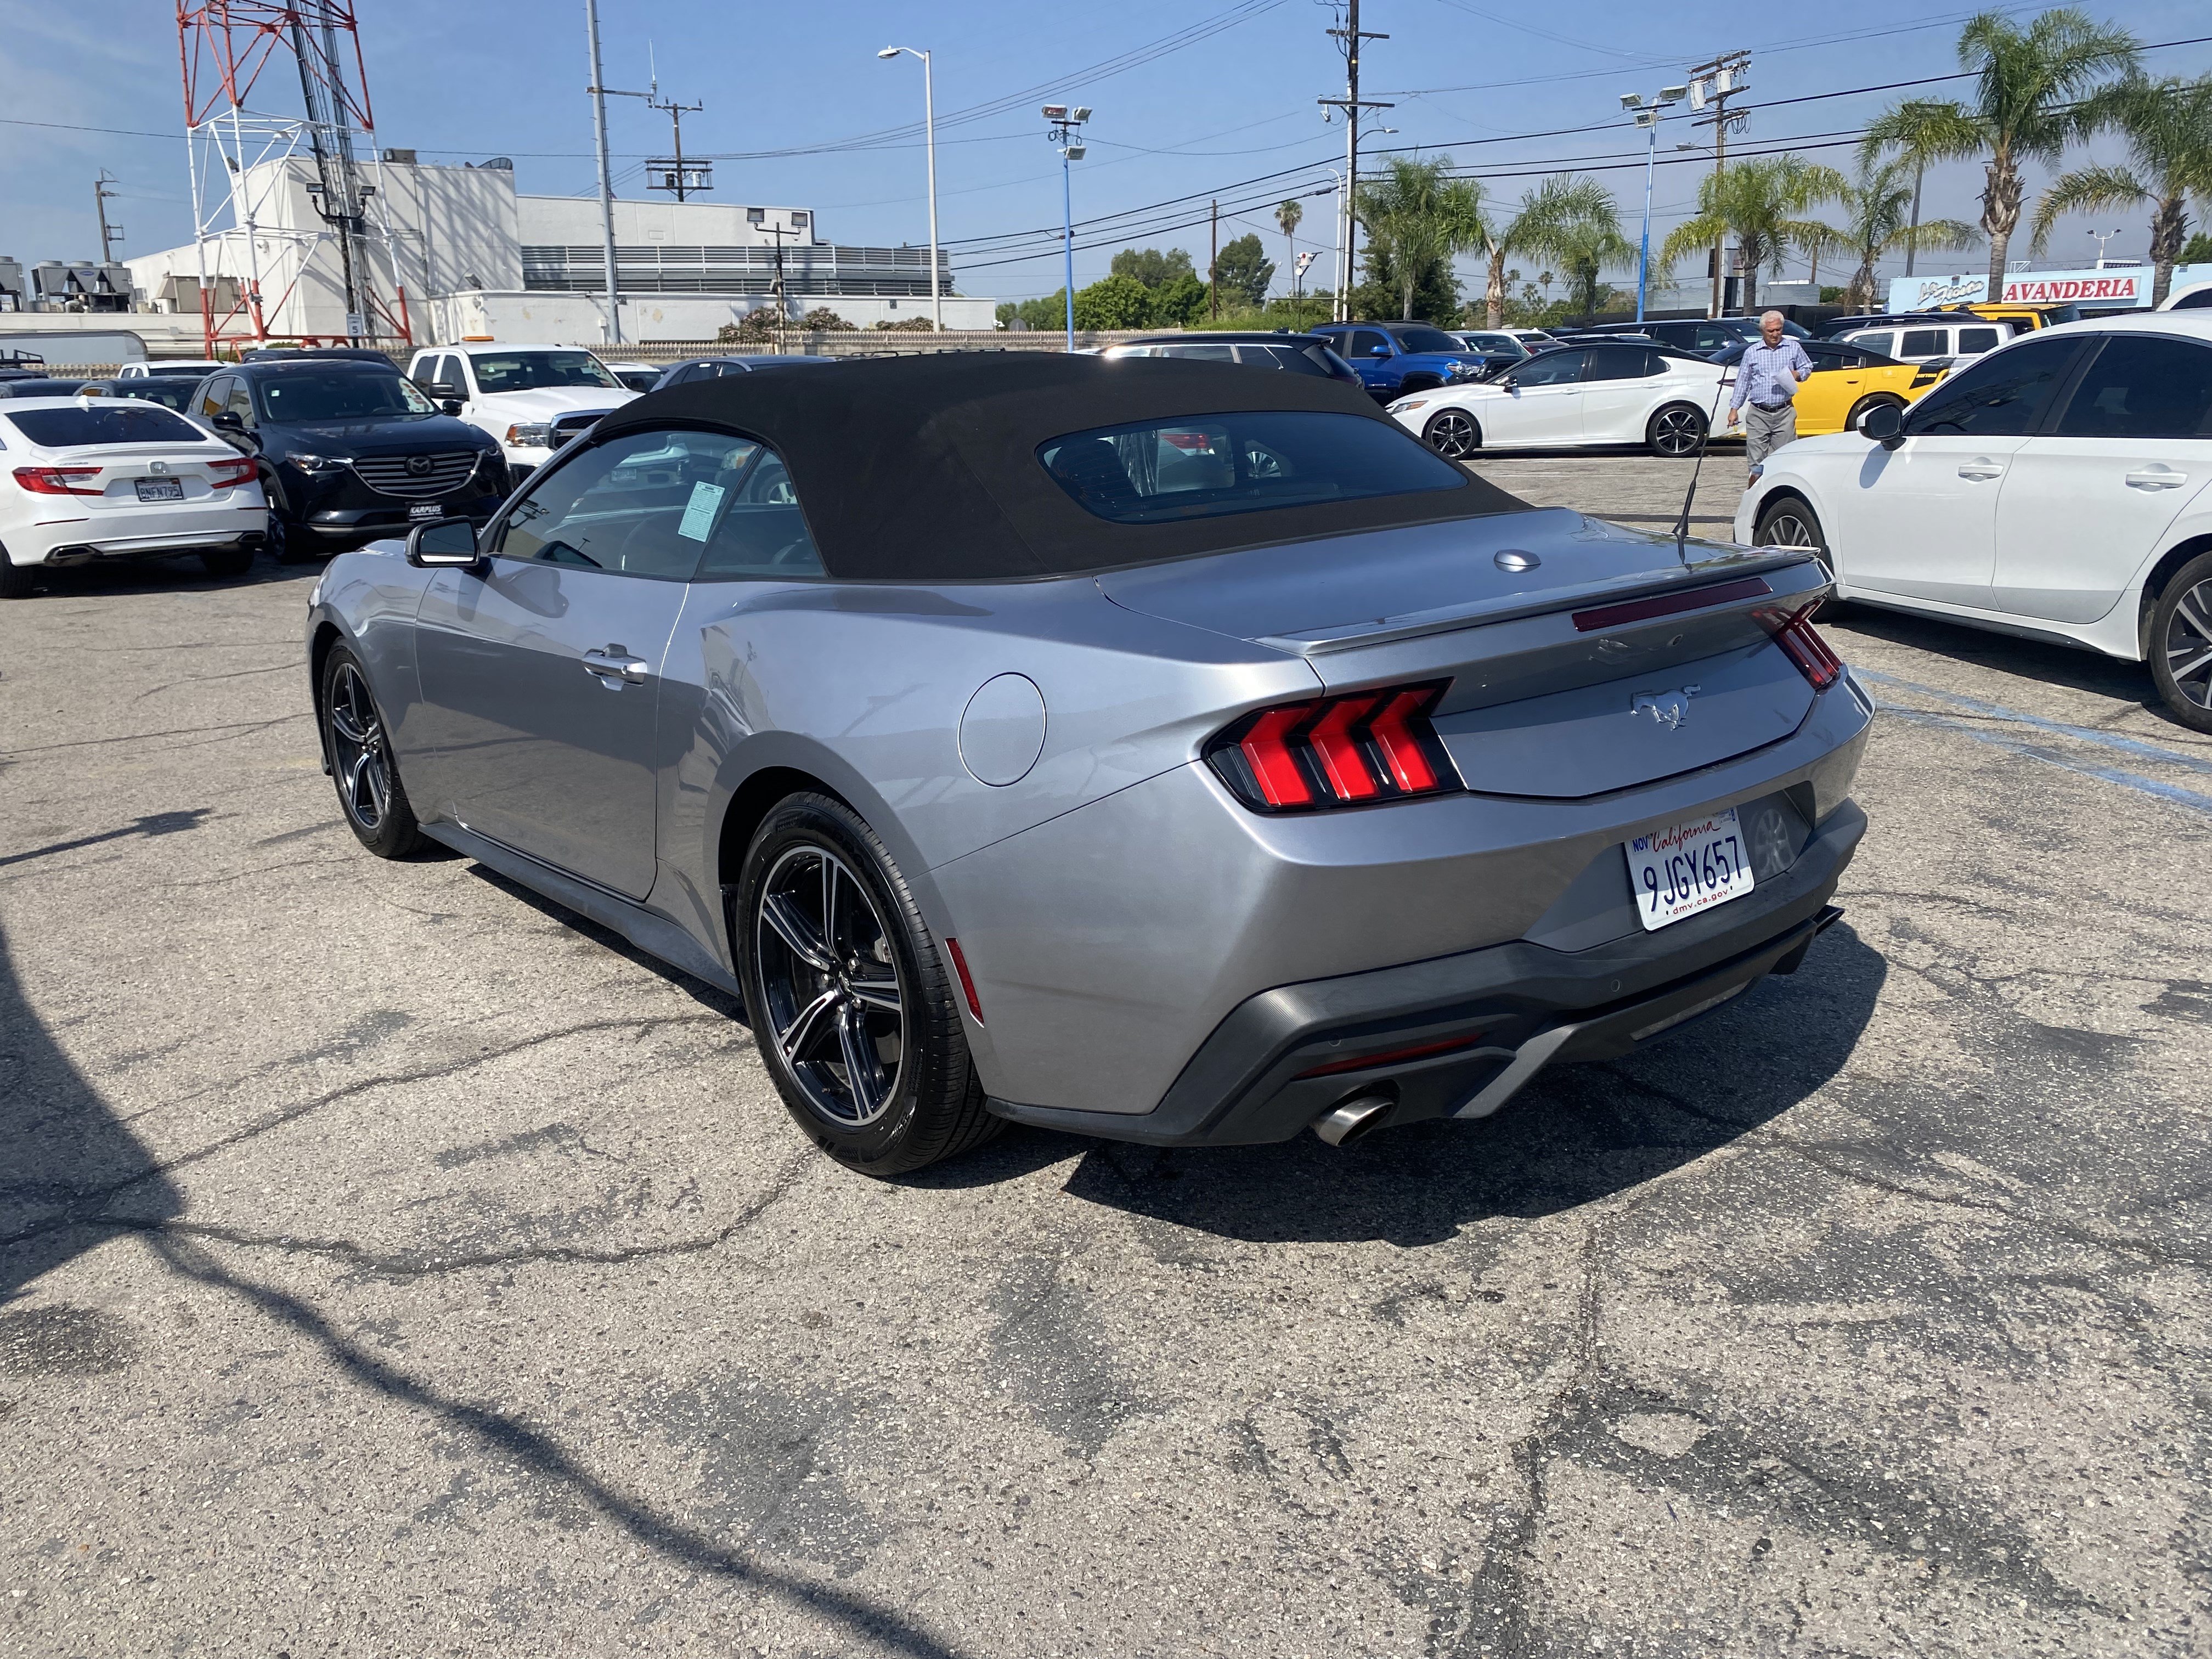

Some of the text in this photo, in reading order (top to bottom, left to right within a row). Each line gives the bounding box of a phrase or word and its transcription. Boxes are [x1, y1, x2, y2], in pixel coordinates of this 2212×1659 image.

[2003, 279, 2134, 301] AVANDERIA
[1633, 821, 1721, 852] NOV California
[1643, 836, 1741, 912] 9JGY657
[1673, 889, 1728, 915] dmv.ca.gov
